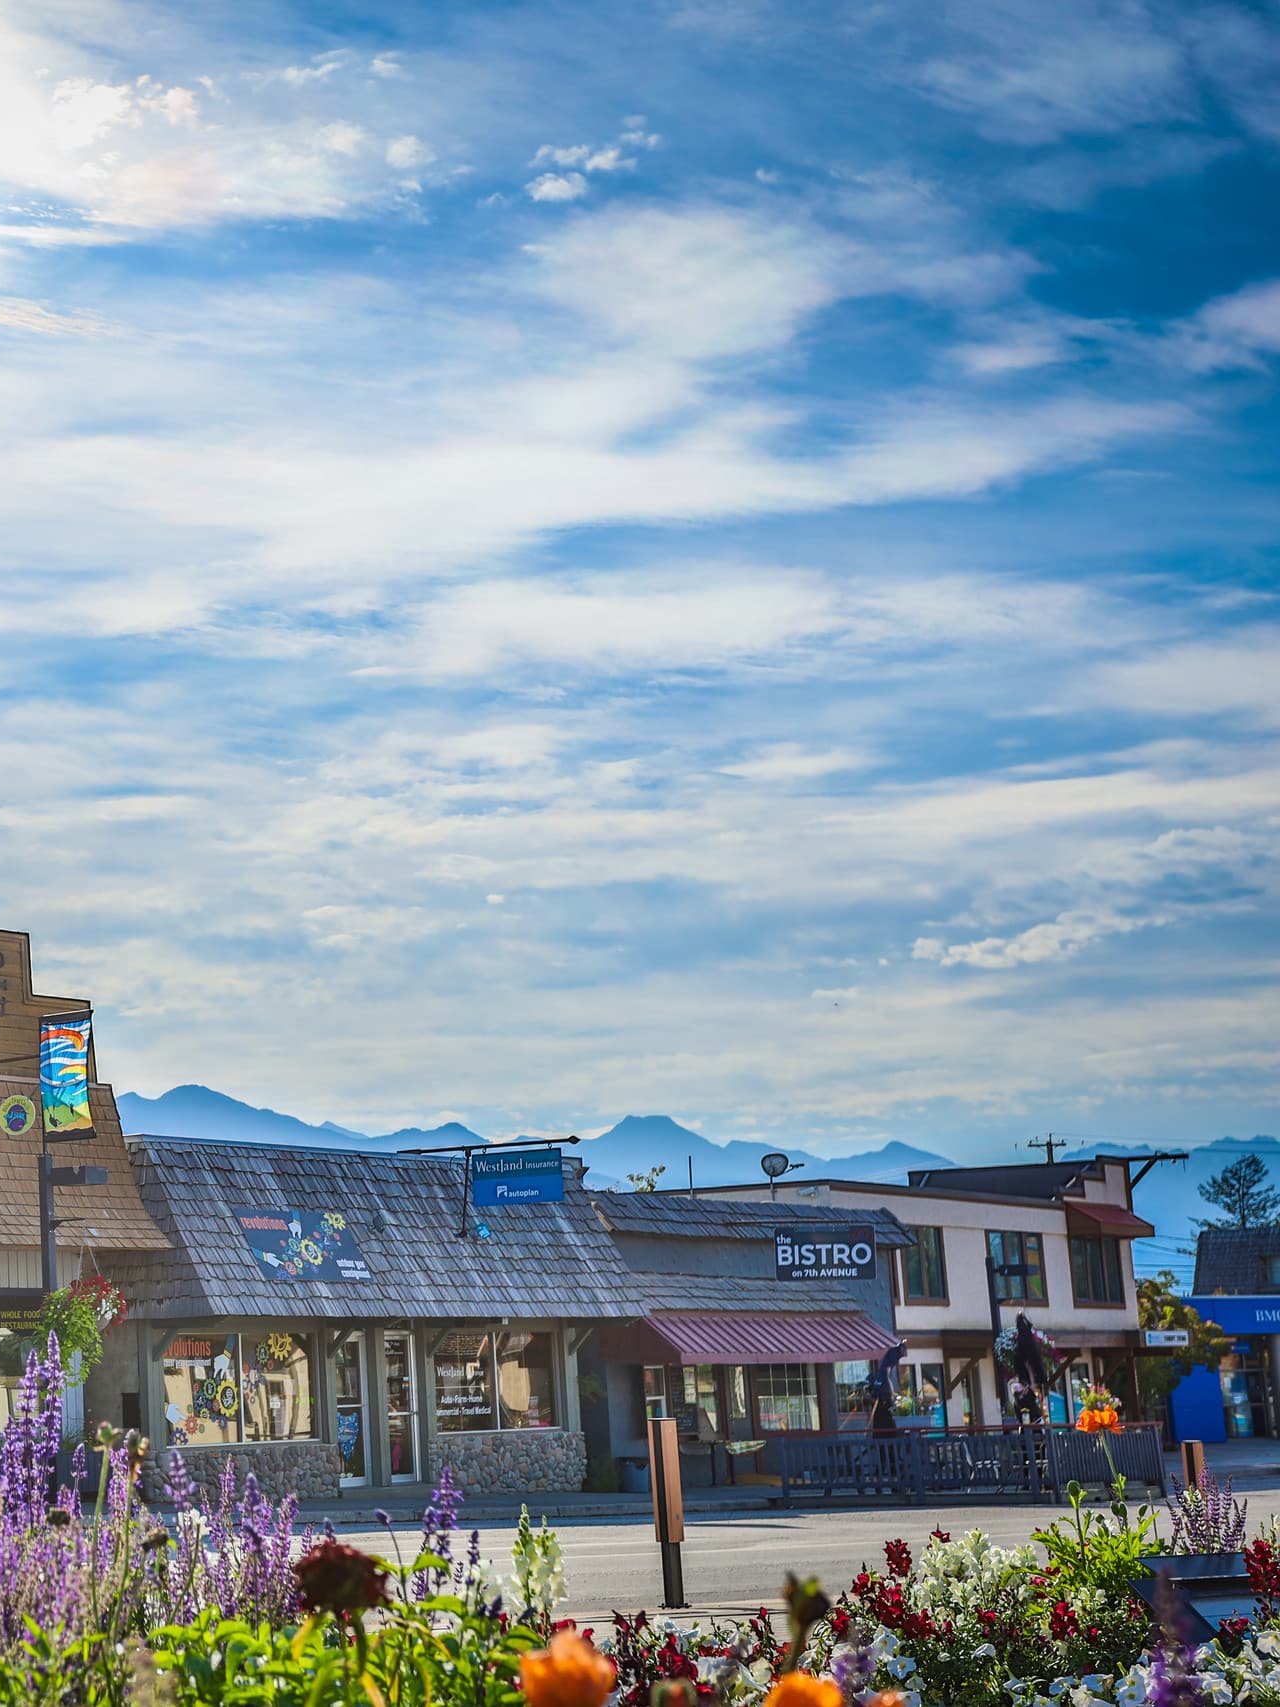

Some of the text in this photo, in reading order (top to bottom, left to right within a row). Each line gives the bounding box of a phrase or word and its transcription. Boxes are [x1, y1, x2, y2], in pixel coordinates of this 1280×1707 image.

[475, 1158, 523, 1173] Westland
[508, 1189, 540, 1198] autoplan
[240, 1215, 288, 1231] revolutions
[776, 1234, 792, 1245] the
[777, 1243, 872, 1266] BISTRO
[792, 1268, 858, 1278] on 7th AVENUE
[0, 1311, 22, 1319] WHOLE
[0, 1320, 40, 1329] RESTAURANT
[162, 1337, 212, 1358] volutions
[436, 1365, 465, 1378] Westland
